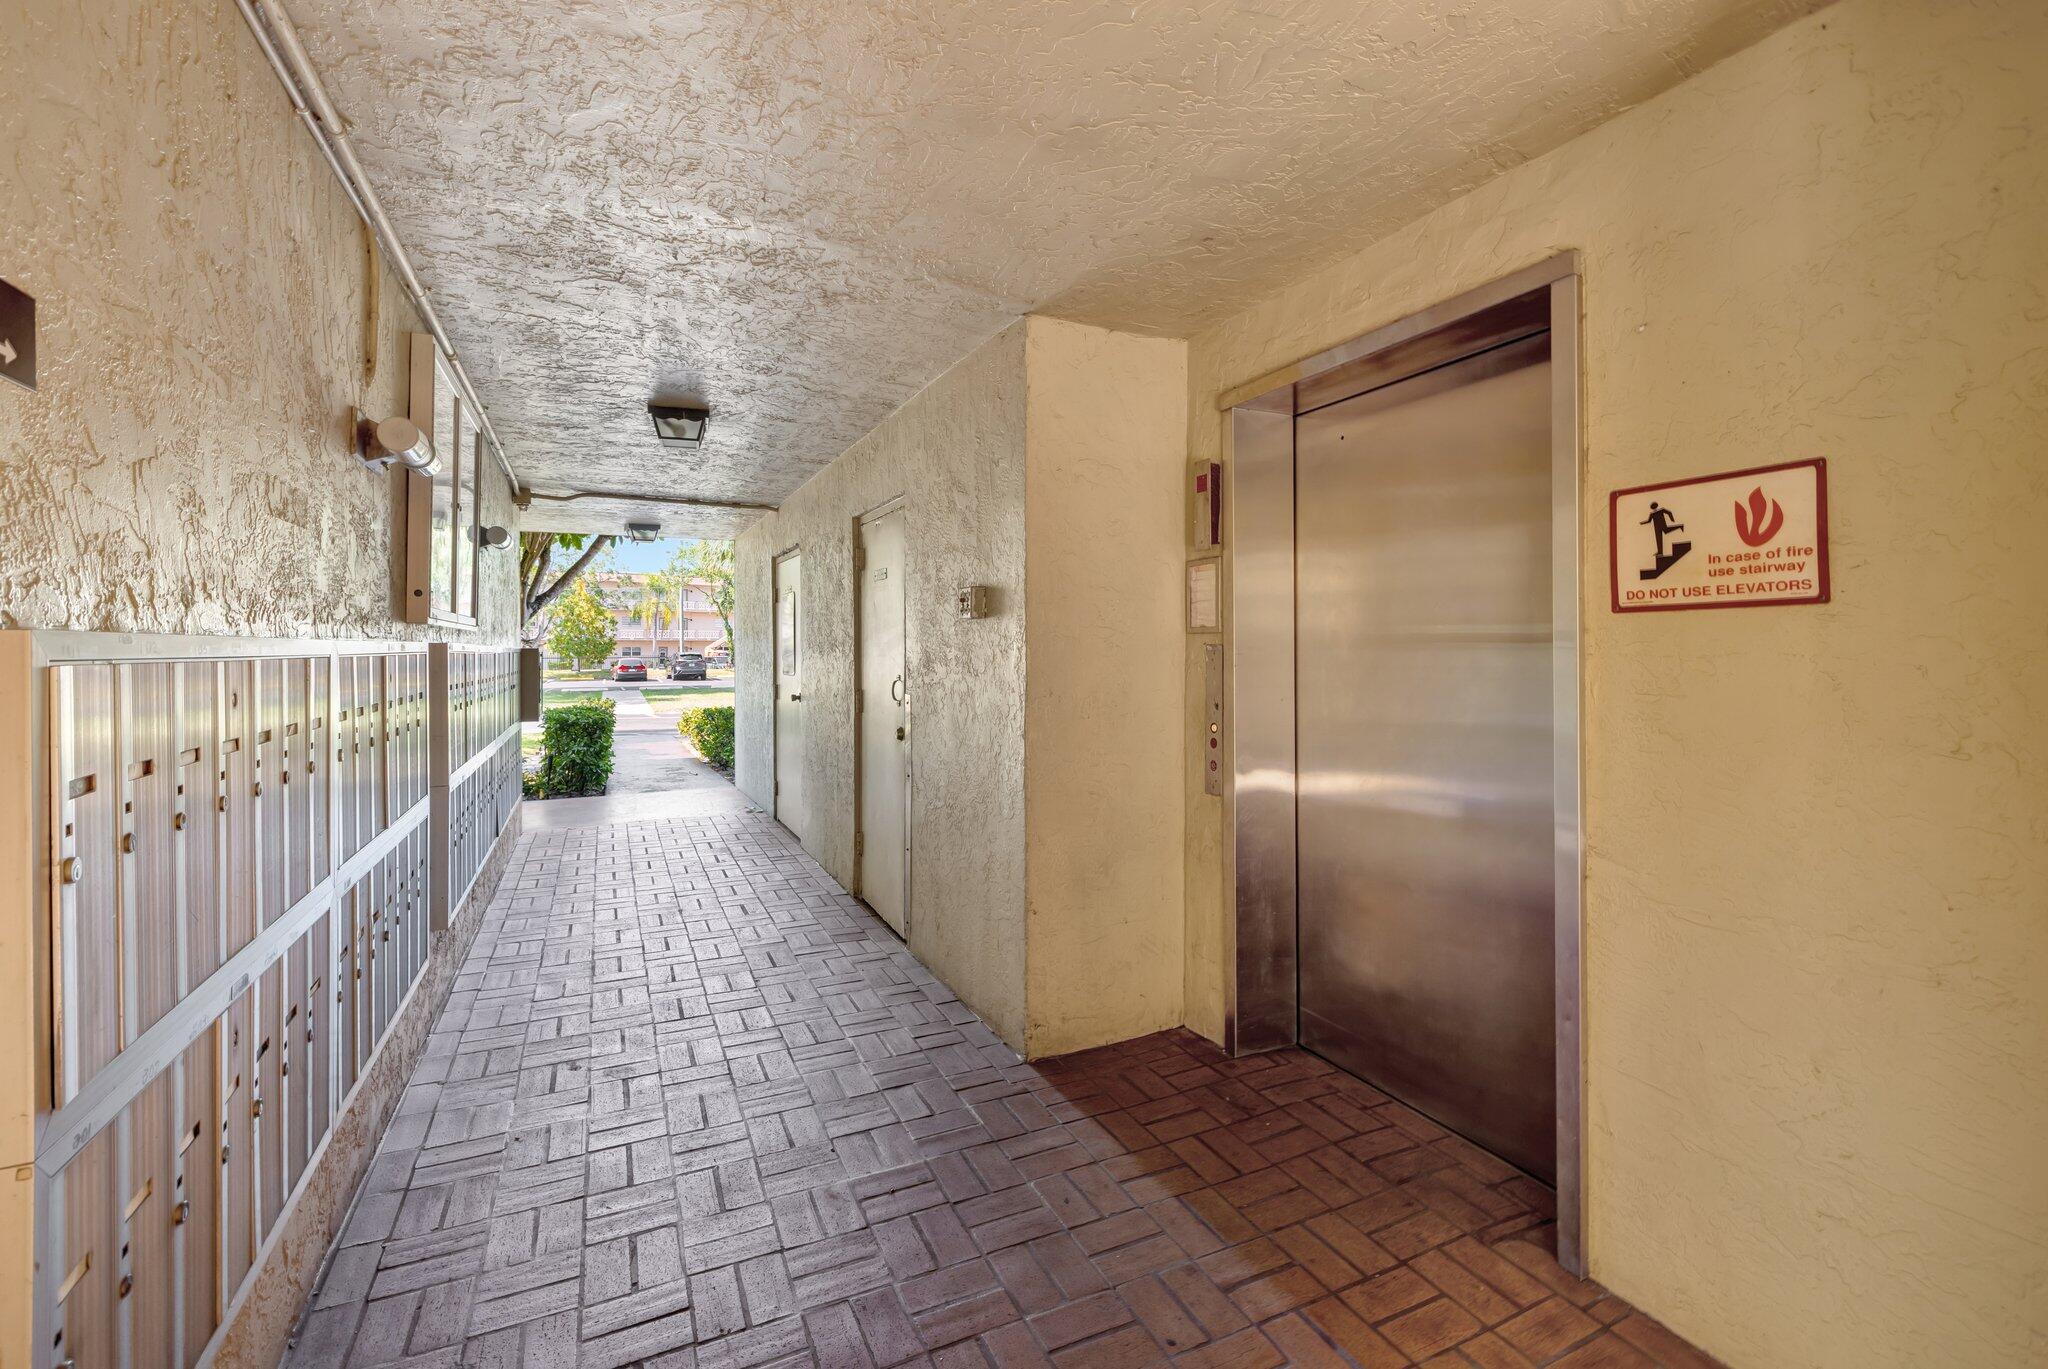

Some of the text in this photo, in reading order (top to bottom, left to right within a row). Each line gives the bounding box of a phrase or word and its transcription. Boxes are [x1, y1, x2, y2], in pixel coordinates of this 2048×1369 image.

[1708, 545, 1814, 564] In case of fire
[1708, 560, 1806, 577] use stairway
[1626, 578, 1813, 601] DO NOT USE ELEVATORS
